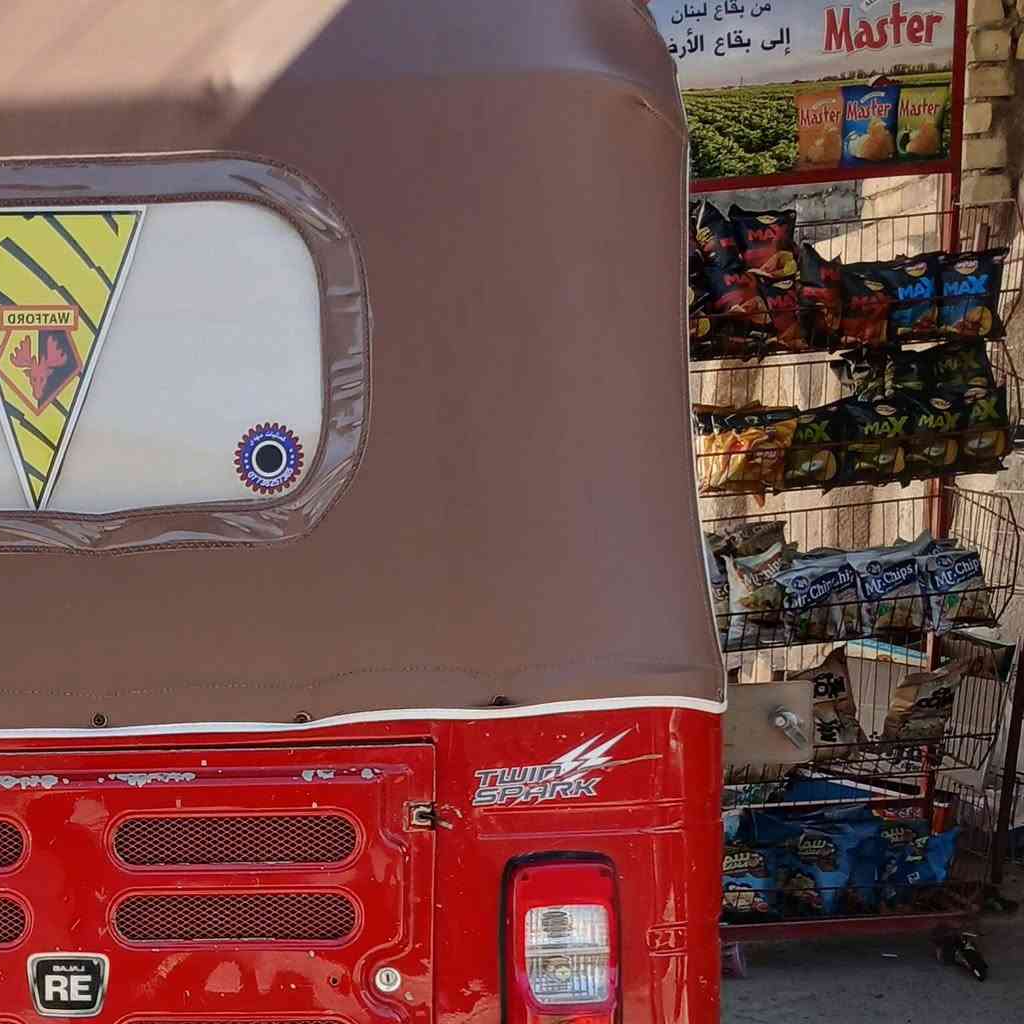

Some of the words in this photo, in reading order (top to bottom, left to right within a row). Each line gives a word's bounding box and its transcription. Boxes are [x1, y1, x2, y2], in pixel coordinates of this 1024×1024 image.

[671, 2, 707, 24] لبنان
[714, 0, 745, 20] بقاع
[751, 1, 772, 17] من
[824, 3, 943, 53] Master
[714, 29, 751, 57] بقاع
[761, 27, 791, 55] إلى
[800, 108, 842, 128] Master
[846, 100, 893, 121] Master
[898, 99, 940, 118] Master
[943, 274, 989, 296] MAX
[971, 399, 999, 418] AX
[864, 416, 908, 436] MAX
[918, 412, 960, 432] MAX
[864, 576, 884, 597] Mr.
[883, 564, 914, 585] Chips
[934, 571, 955, 588] Mr.
[954, 557, 979, 579] Chip
[475, 762, 563, 788] TWIN
[472, 777, 602, 807] SPARK
[44, 974, 92, 1001] RE
